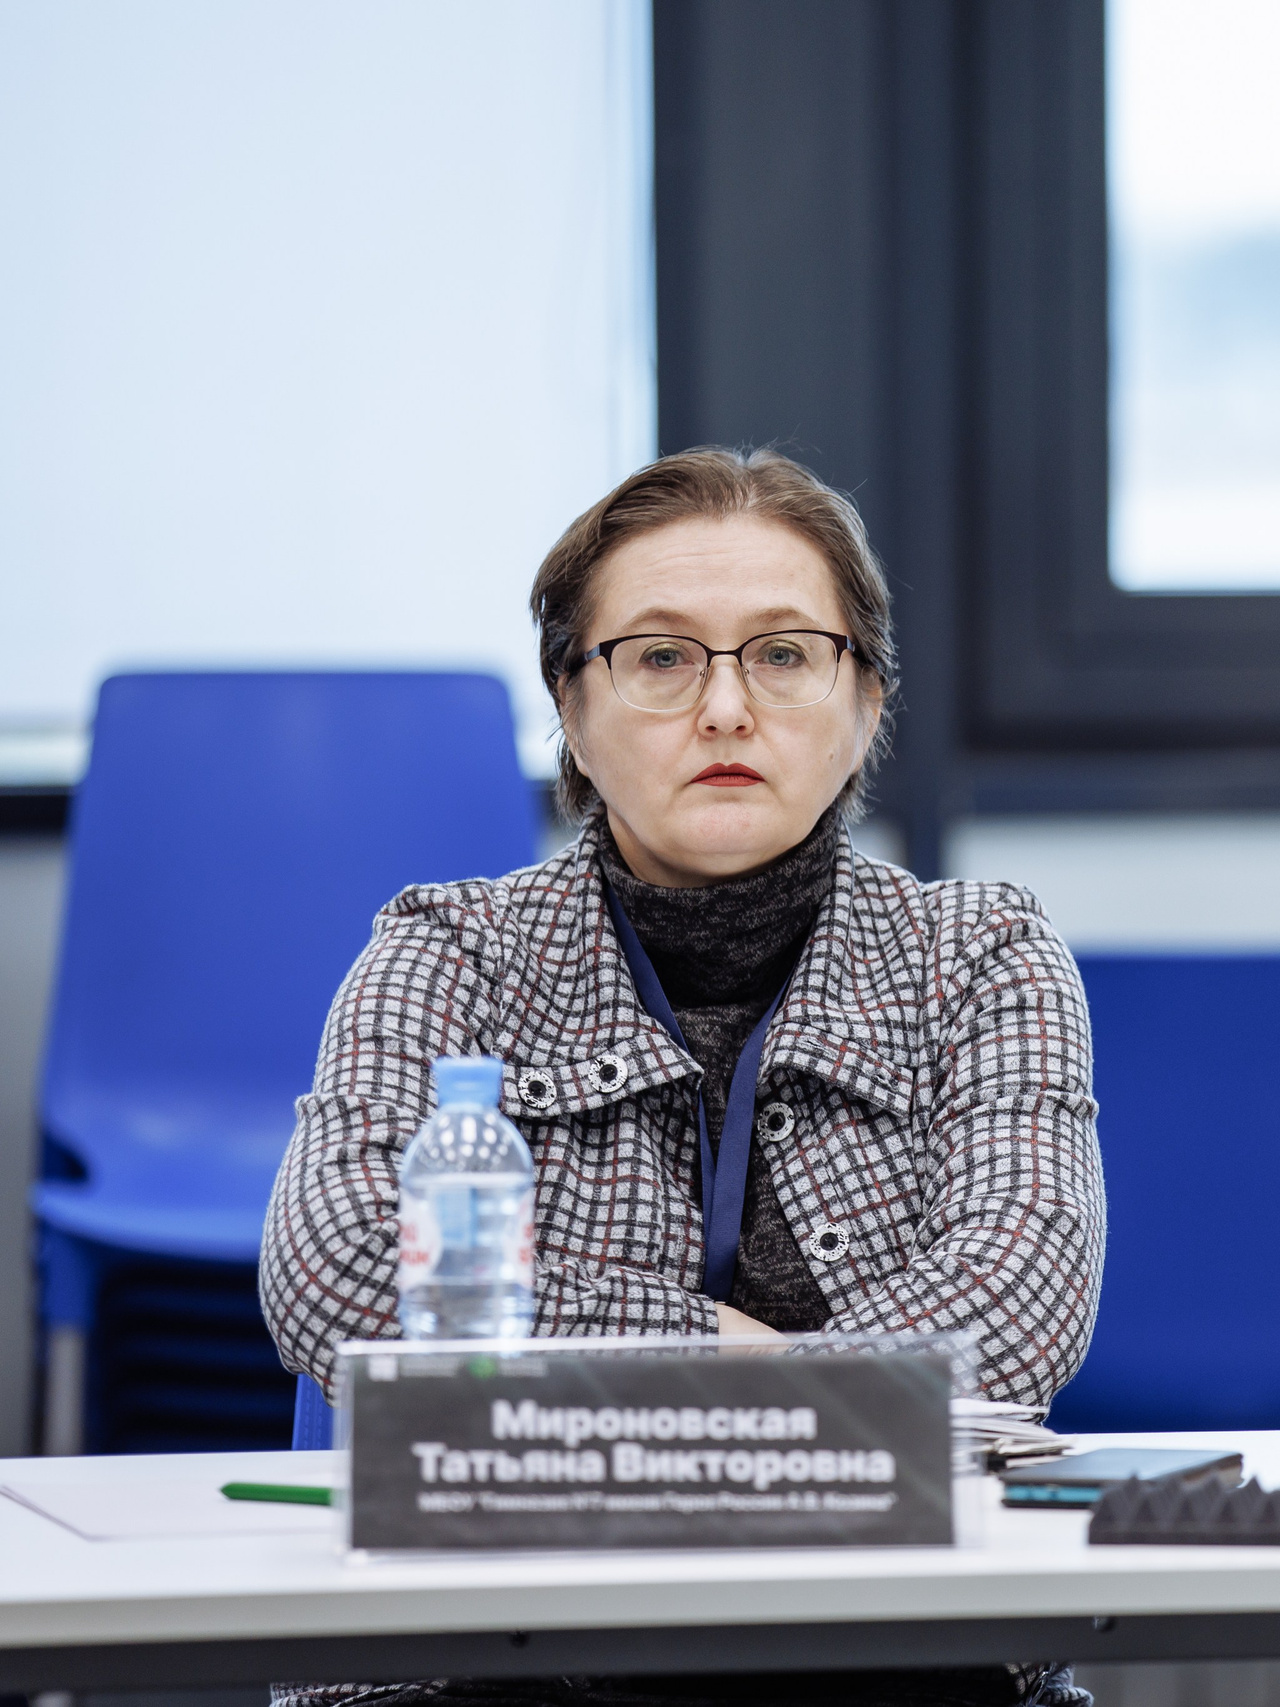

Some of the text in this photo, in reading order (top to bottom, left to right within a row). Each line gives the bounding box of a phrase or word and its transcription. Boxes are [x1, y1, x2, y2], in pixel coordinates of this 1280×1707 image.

[492, 1399, 817, 1447] Мироновская
[412, 1441, 896, 1490] Татьяна Викторовна
